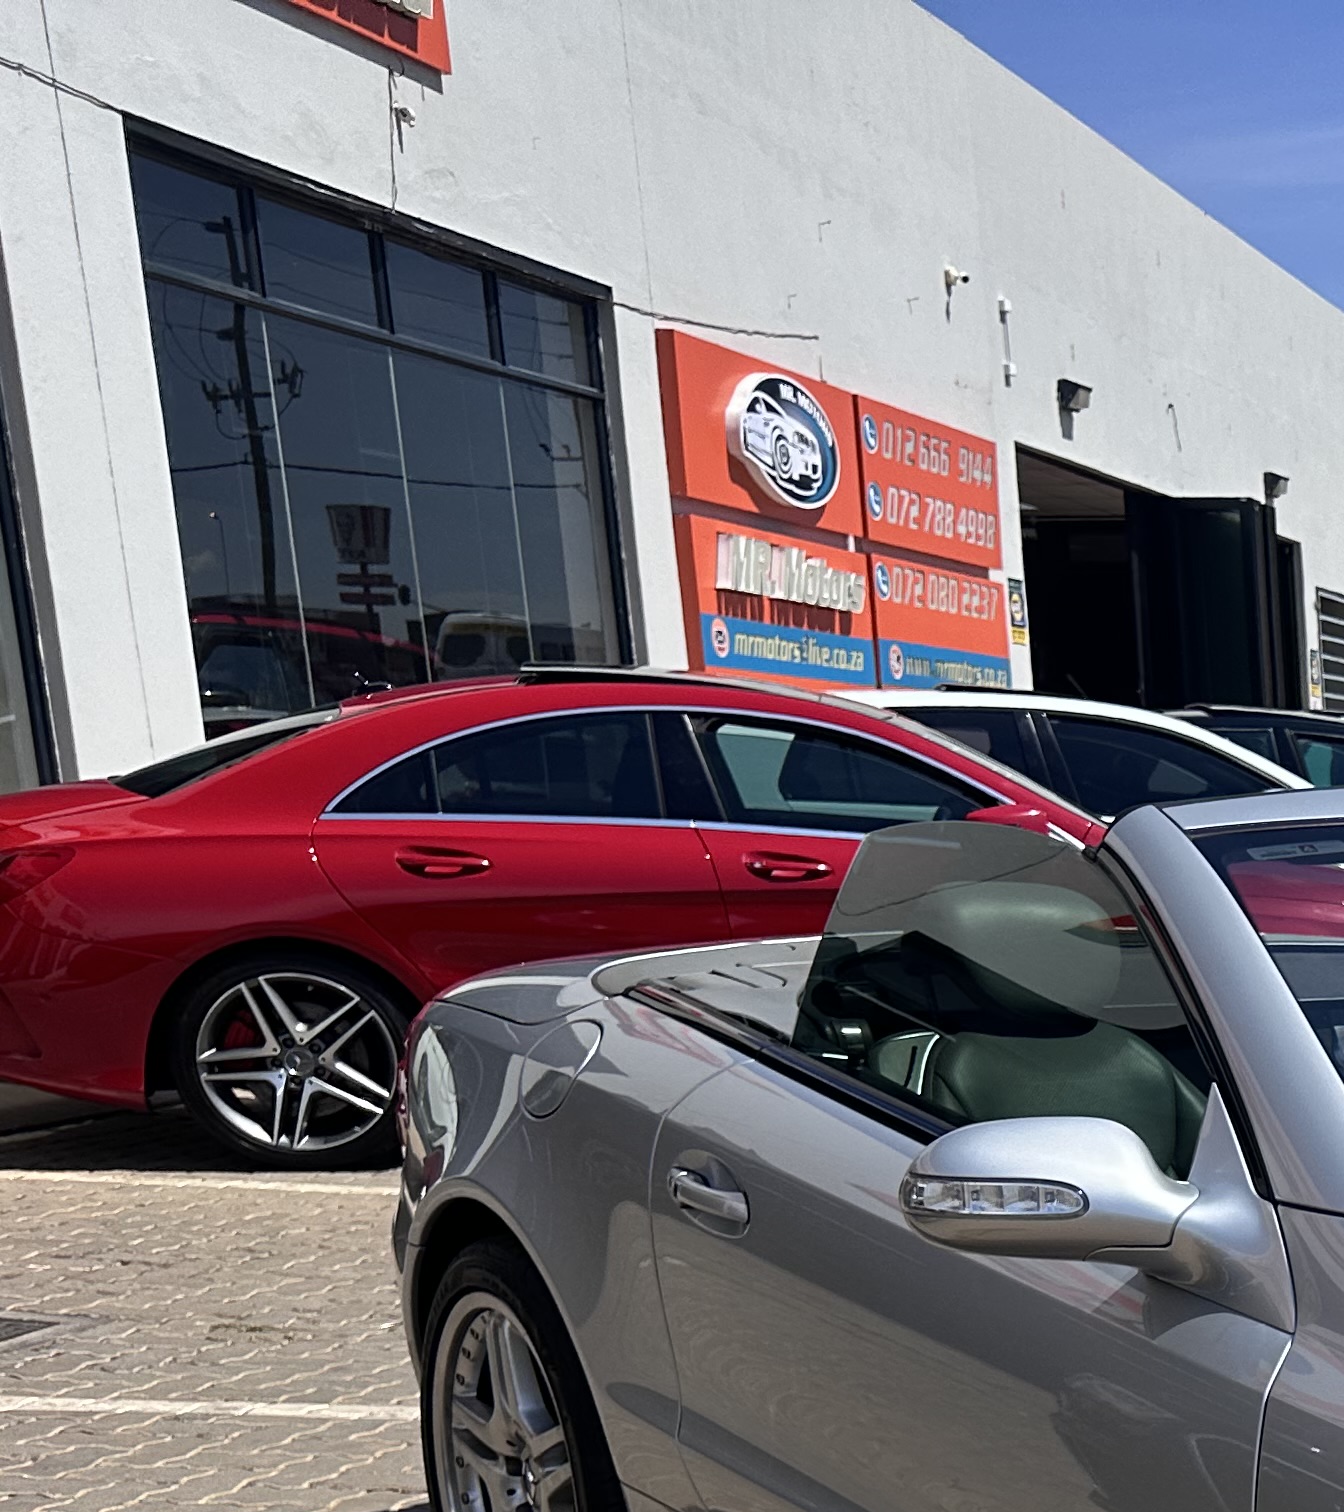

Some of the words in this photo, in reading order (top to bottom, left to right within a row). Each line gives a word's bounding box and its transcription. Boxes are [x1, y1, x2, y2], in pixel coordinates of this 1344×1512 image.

[882, 421, 916, 466] 012
[919, 432, 951, 477] 666
[958, 446, 993, 490] 9144
[886, 485, 920, 530] 072
[924, 496, 954, 539] 788
[769, 546, 866, 614] Motors
[892, 565, 924, 609] 072
[927, 573, 958, 614] 080
[961, 580, 999, 622] 2237
